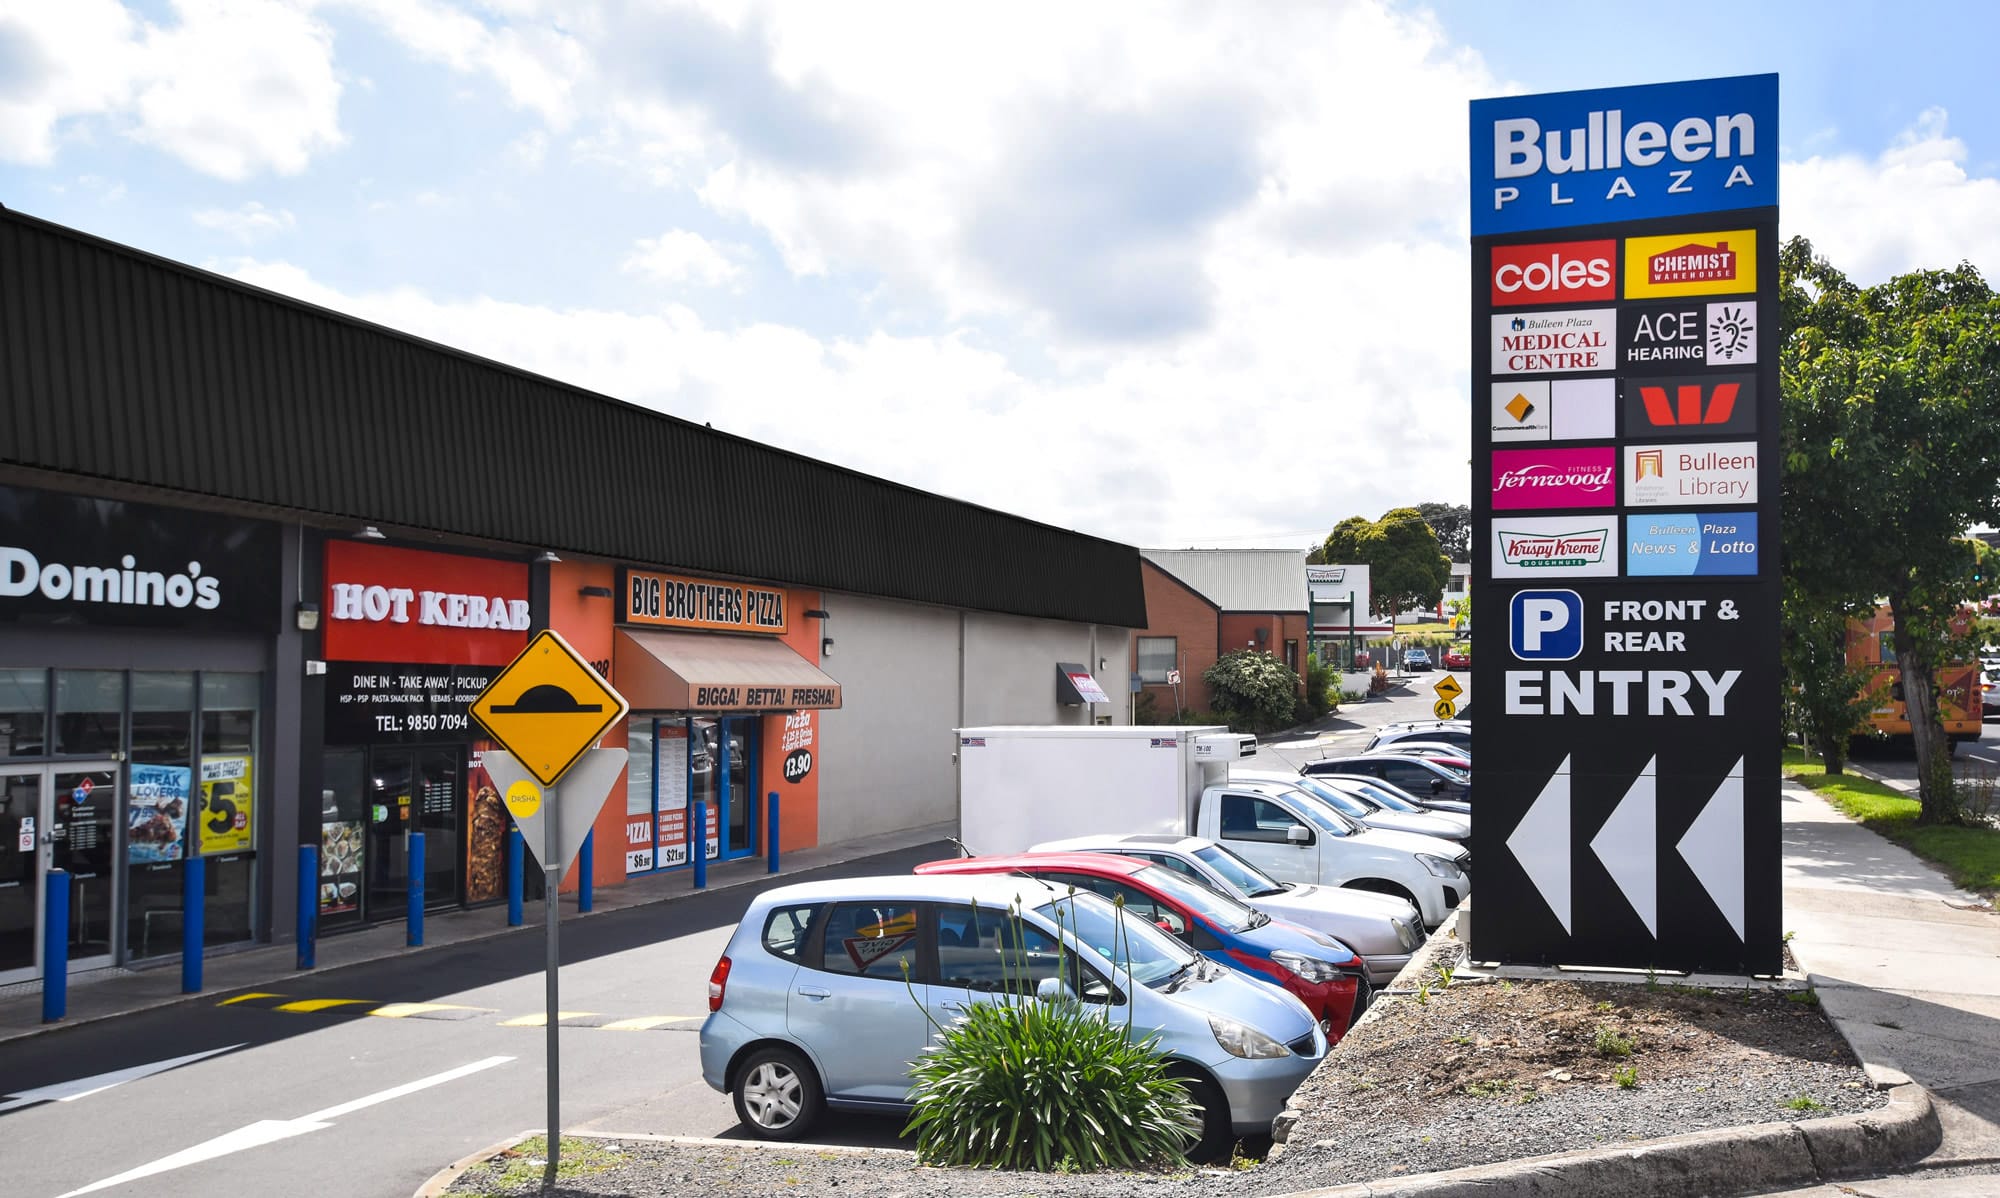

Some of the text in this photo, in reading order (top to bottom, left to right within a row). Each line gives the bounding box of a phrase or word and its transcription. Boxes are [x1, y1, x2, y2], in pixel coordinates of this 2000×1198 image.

[1494, 109, 1755, 180] Bulleen
[1494, 165, 1754, 211] PLAZA
[1495, 253, 1611, 293] coles
[1653, 253, 1731, 273] CHEMIST
[1654, 269, 1731, 281] WAREHOUSE
[1528, 317, 1593, 329] Bulleen Plaza
[1633, 311, 1699, 342] ACE
[1502, 331, 1607, 352] MEDICAL
[1508, 351, 1599, 371] CENTRE
[1627, 345, 1704, 361] HEARING
[1567, 465, 1602, 473] FITNESS
[1679, 452, 1755, 472] Bulleen
[1493, 466, 1612, 492] fernwood
[1679, 477, 1749, 499] Library
[1649, 524, 1737, 535] Bulleen Plaza
[1507, 537, 1601, 558] Krispy Kreme
[1631, 540, 1755, 554] News & Lotto
[1523, 559, 1584, 567] DOUGHNUTS
[0, 546, 221, 610] Domino's
[331, 582, 531, 631] HOT KEBAB
[631, 575, 783, 628] BIG BROTHERS PIZZA
[1604, 599, 1740, 621] FRONT &
[1523, 598, 1569, 651] P
[1604, 631, 1686, 652] REAR
[353, 675, 377, 689] DINE
[379, 676, 390, 689] IN
[398, 676, 422, 689] TAKE
[424, 676, 449, 689] AWAY
[457, 677, 488, 689] PICKUP
[371, 695, 389, 703] PASTA
[454, 695, 479, 703] KOOBIDE
[697, 687, 835, 705] BIGGA! BETTA! FRESHA!
[1505, 670, 1743, 716] ENTRY
[376, 714, 468, 731] TEL: 9850 7094
[138, 772, 182, 786] STEAK
[136, 786, 180, 797] LOVERS
